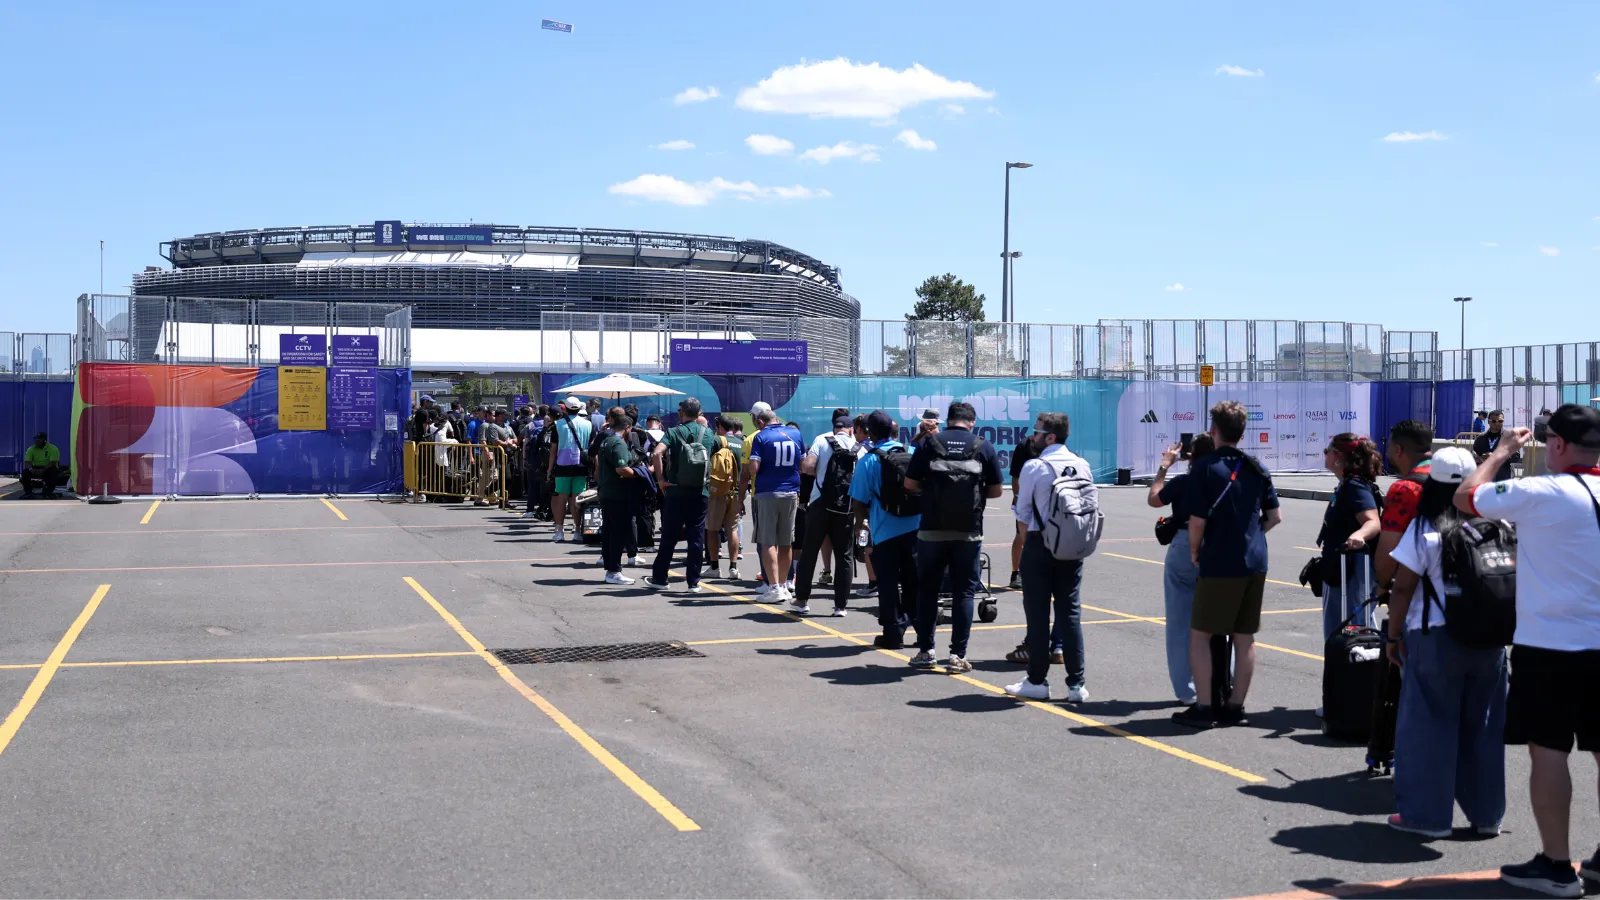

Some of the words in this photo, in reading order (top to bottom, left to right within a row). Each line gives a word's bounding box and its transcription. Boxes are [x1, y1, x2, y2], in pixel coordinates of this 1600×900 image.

[898, 395, 954, 420] WE
[962, 396, 1030, 420] ARE
[1339, 412, 1357, 420] VISA
[774, 441, 795, 466] 10
